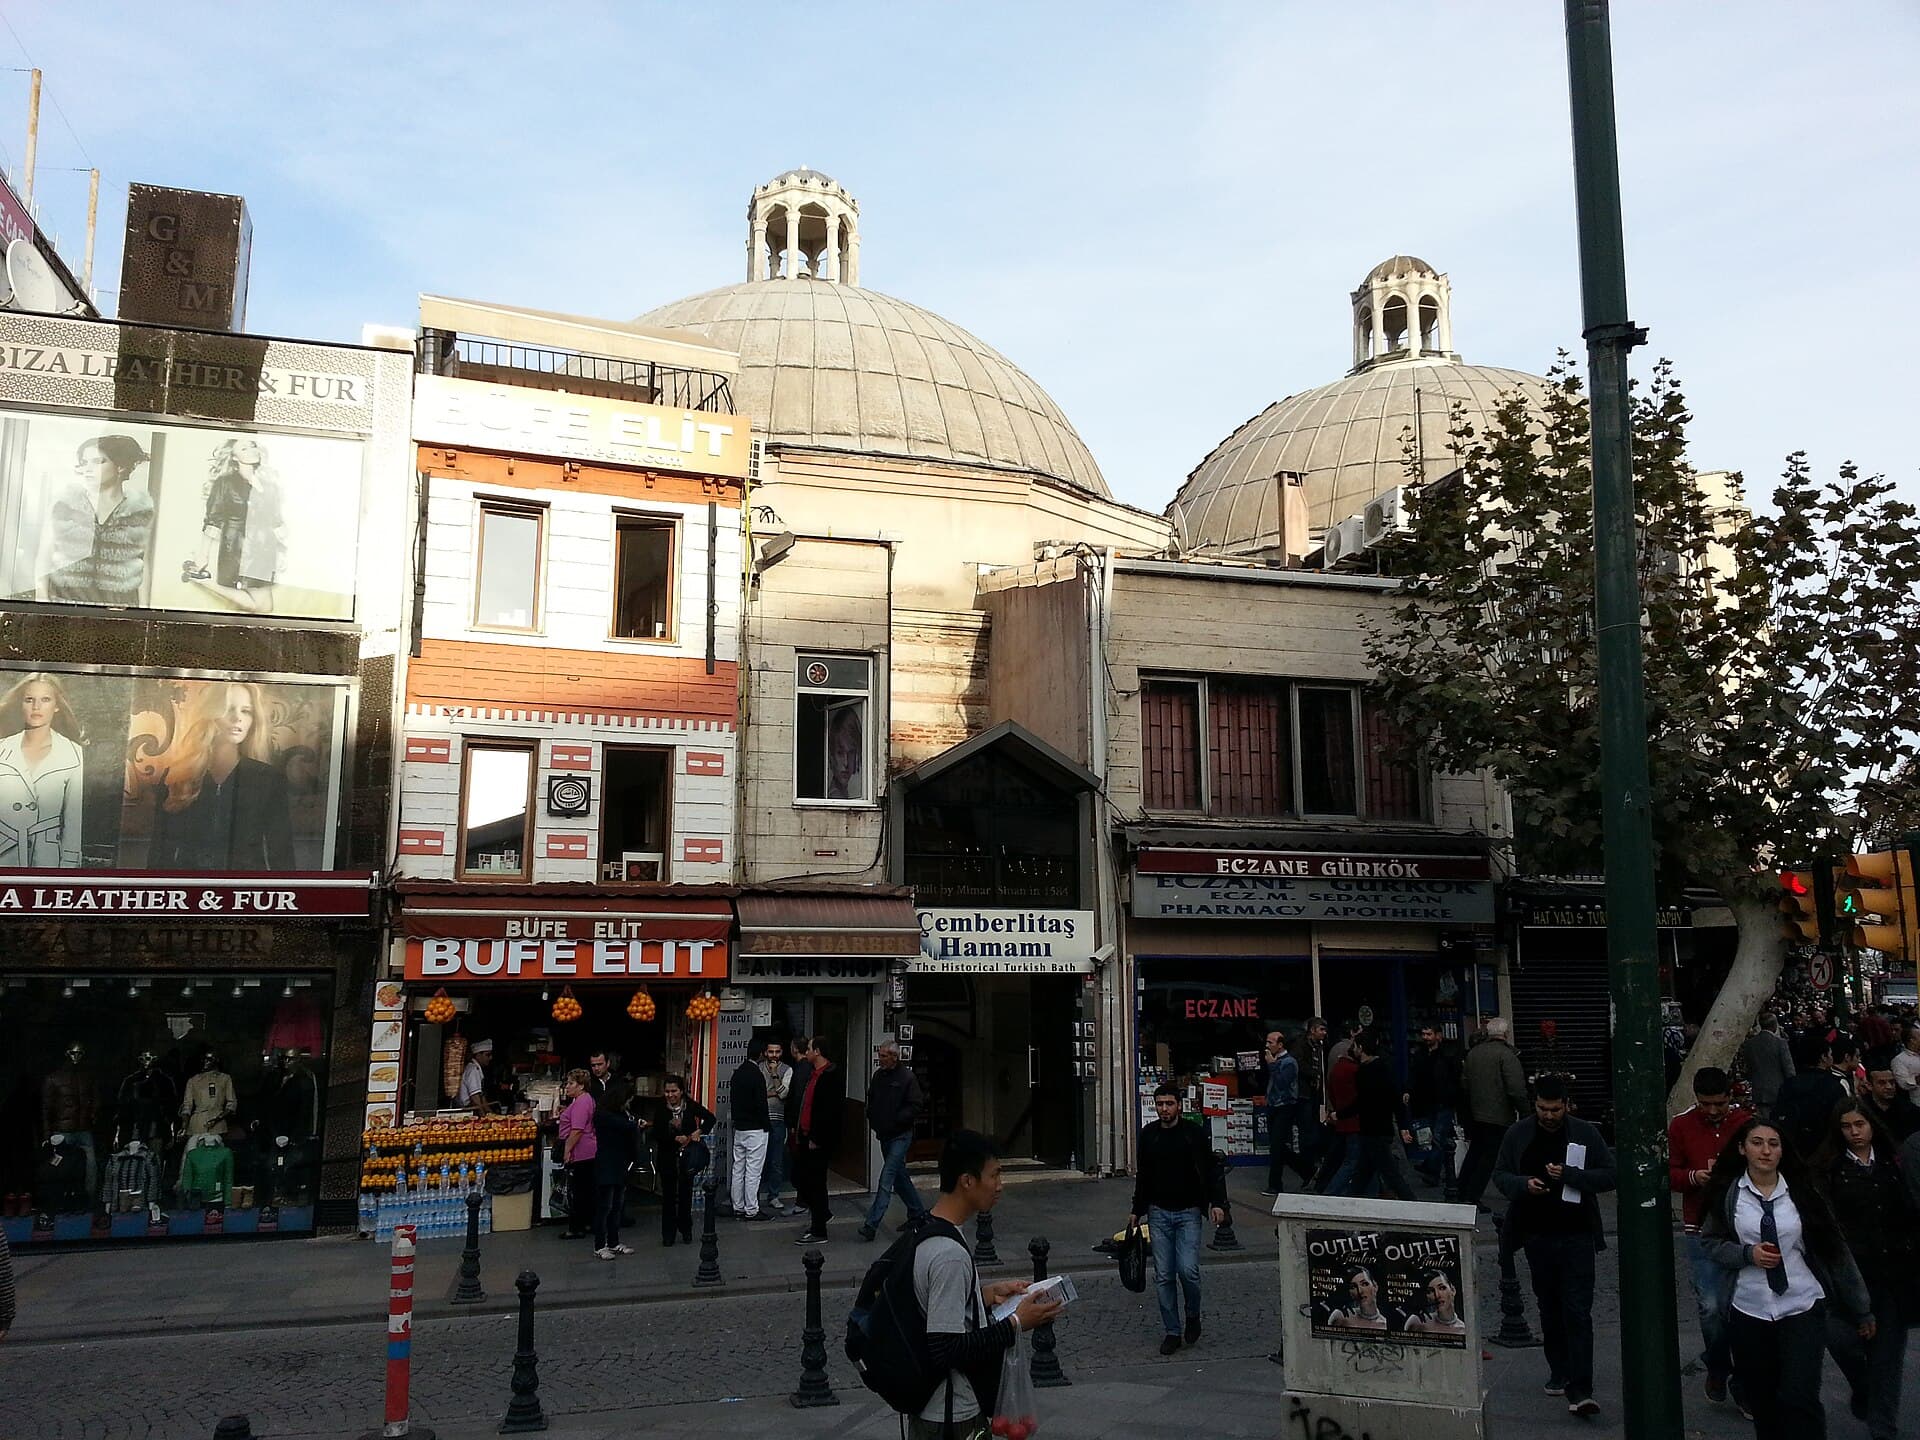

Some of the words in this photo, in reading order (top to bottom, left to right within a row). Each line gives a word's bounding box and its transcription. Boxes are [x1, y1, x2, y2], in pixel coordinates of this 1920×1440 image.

[149, 215, 177, 242] G
[166, 249, 190, 276] &
[184, 286, 217, 312] M
[81, 352, 247, 392] LEATHER
[260, 371, 278, 394] &
[288, 374, 357, 402] FUR
[1216, 858, 1309, 875] ECZANE
[1321, 857, 1421, 878] GÜRKÖK
[1157, 875, 1296, 890] ECZANE
[32, 889, 190, 911] LEATHER
[199, 890, 223, 911] &
[232, 890, 299, 911] FUR
[1309, 893, 1383, 902] SEDAT
[1391, 895, 1442, 905] CAN
[1161, 904, 1306, 916] PHARMACY
[1324, 907, 1454, 919] APOTHEKE
[506, 917, 568, 938] BÜFE
[594, 918, 642, 939] ELİT
[917, 912, 1076, 939] Çemberlitaş
[750, 935, 816, 952] ATAK
[820, 935, 915, 952] BARBER
[939, 938, 1052, 958] Hamamı
[737, 959, 821, 977] BARBER
[828, 959, 883, 978] SHOP
[916, 963, 936, 972] The
[941, 962, 999, 972] Historical
[1004, 962, 1048, 972] Turkish
[1051, 963, 1077, 972] Bath
[1185, 998, 1260, 1019] ECZANE
[720, 1015, 751, 1024] HAIRCUT
[729, 1028, 742, 1036] and
[721, 1041, 749, 1050] SHAVE
[1310, 1233, 1381, 1257] OUTLET
[1385, 1237, 1457, 1261] OUTLET
